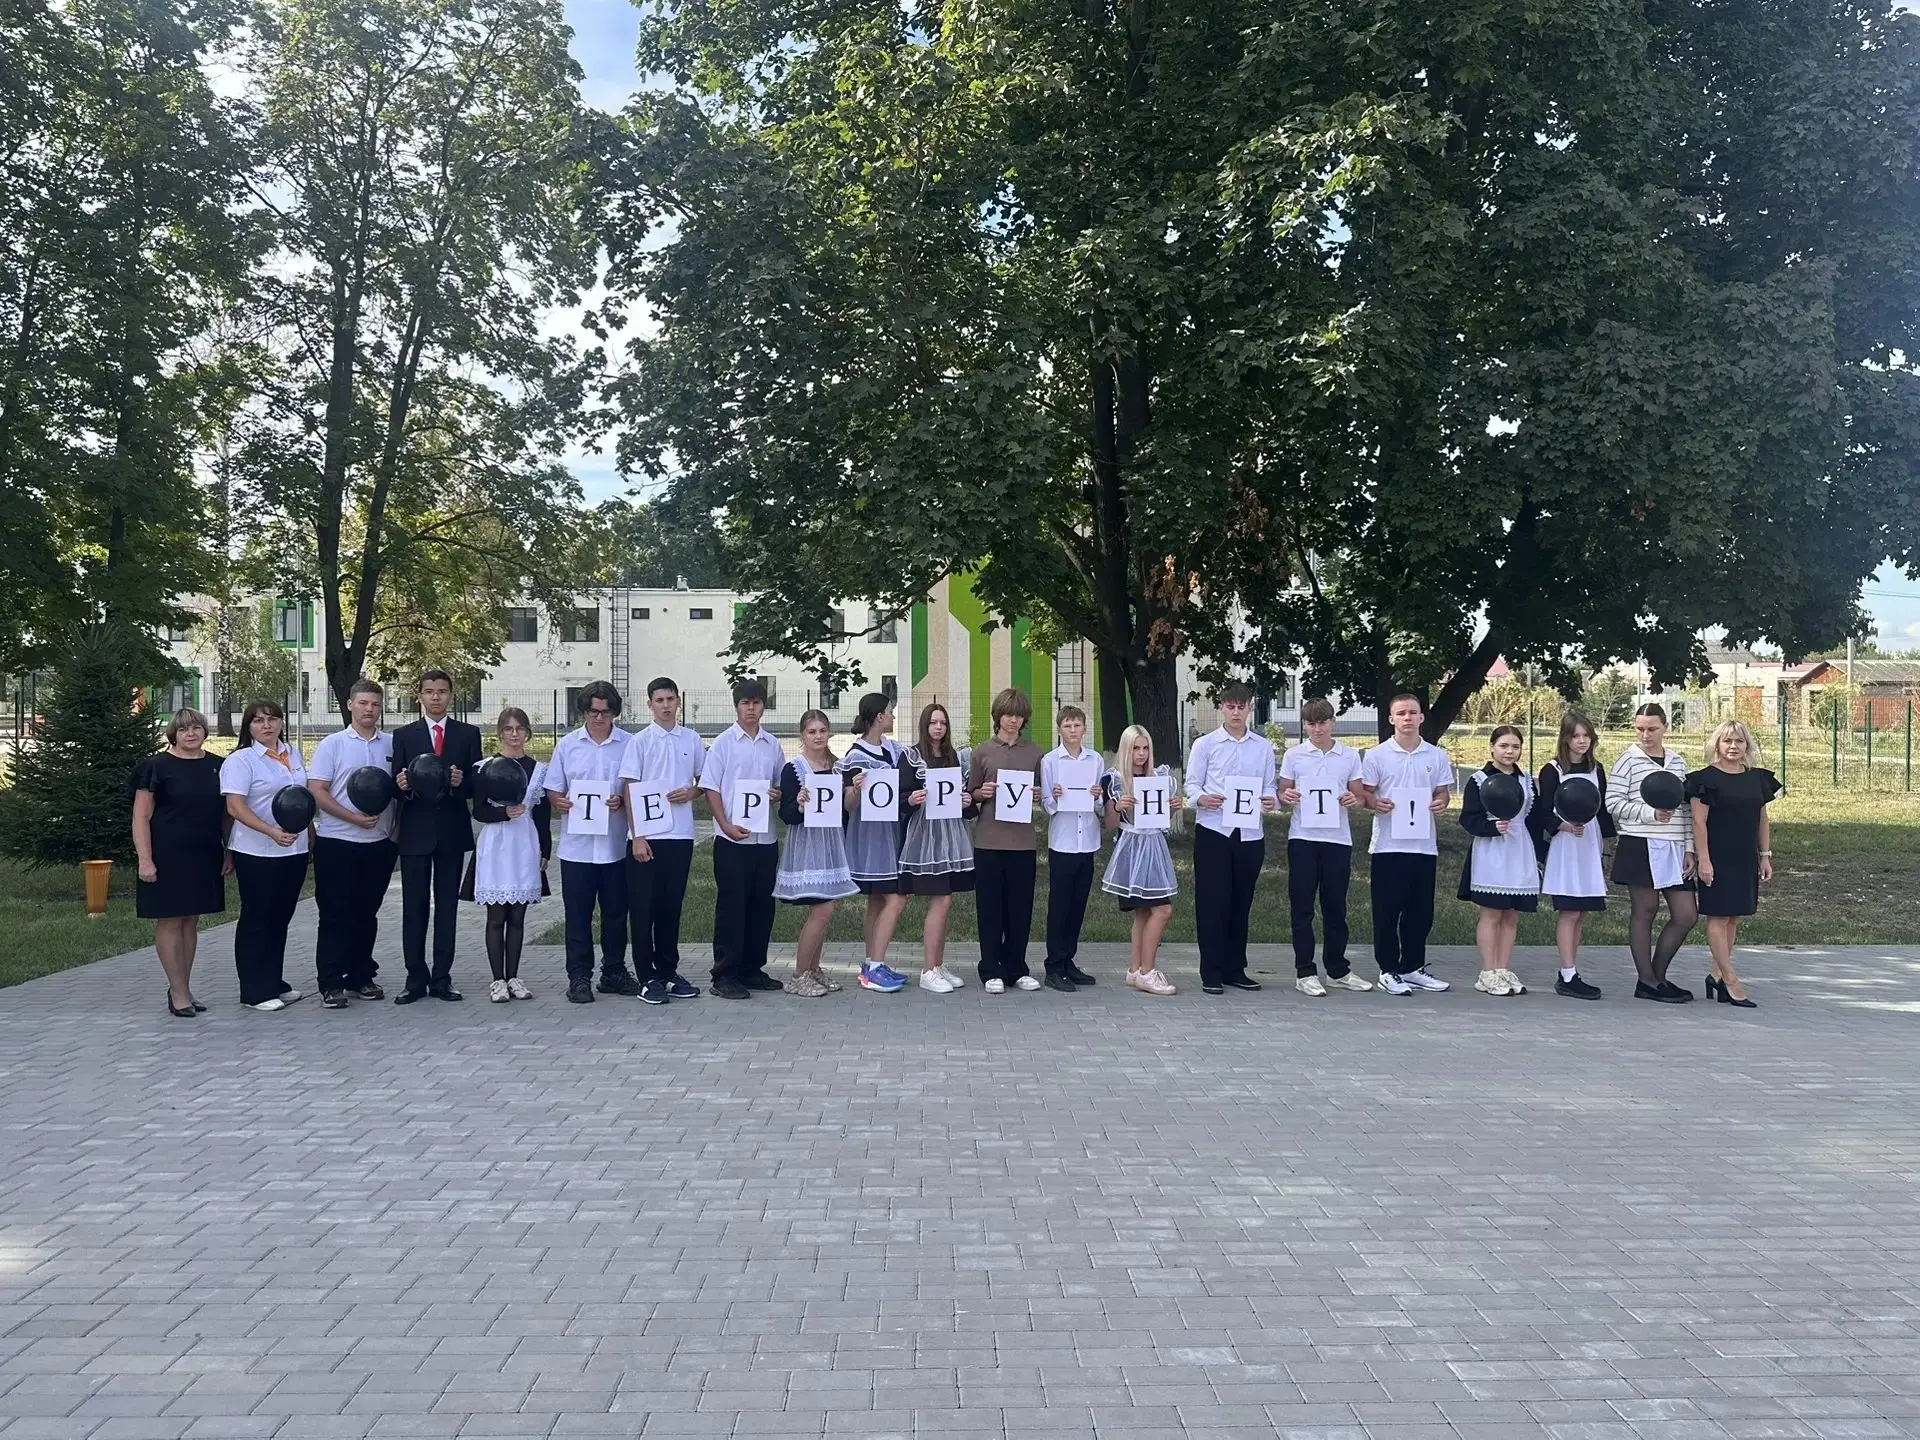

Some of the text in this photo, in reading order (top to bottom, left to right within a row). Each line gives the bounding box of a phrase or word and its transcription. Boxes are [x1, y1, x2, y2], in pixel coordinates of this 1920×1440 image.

[577, 793, 601, 821] Т
[640, 792, 664, 822] Е
[741, 792, 762, 819] Р
[815, 787, 835, 814] Р
[868, 780, 895, 809] О
[935, 780, 955, 807] Р
[1003, 782, 1029, 810] У
[1141, 789, 1165, 816] Н
[1233, 788, 1254, 815] Е
[1309, 788, 1332, 815] Т
